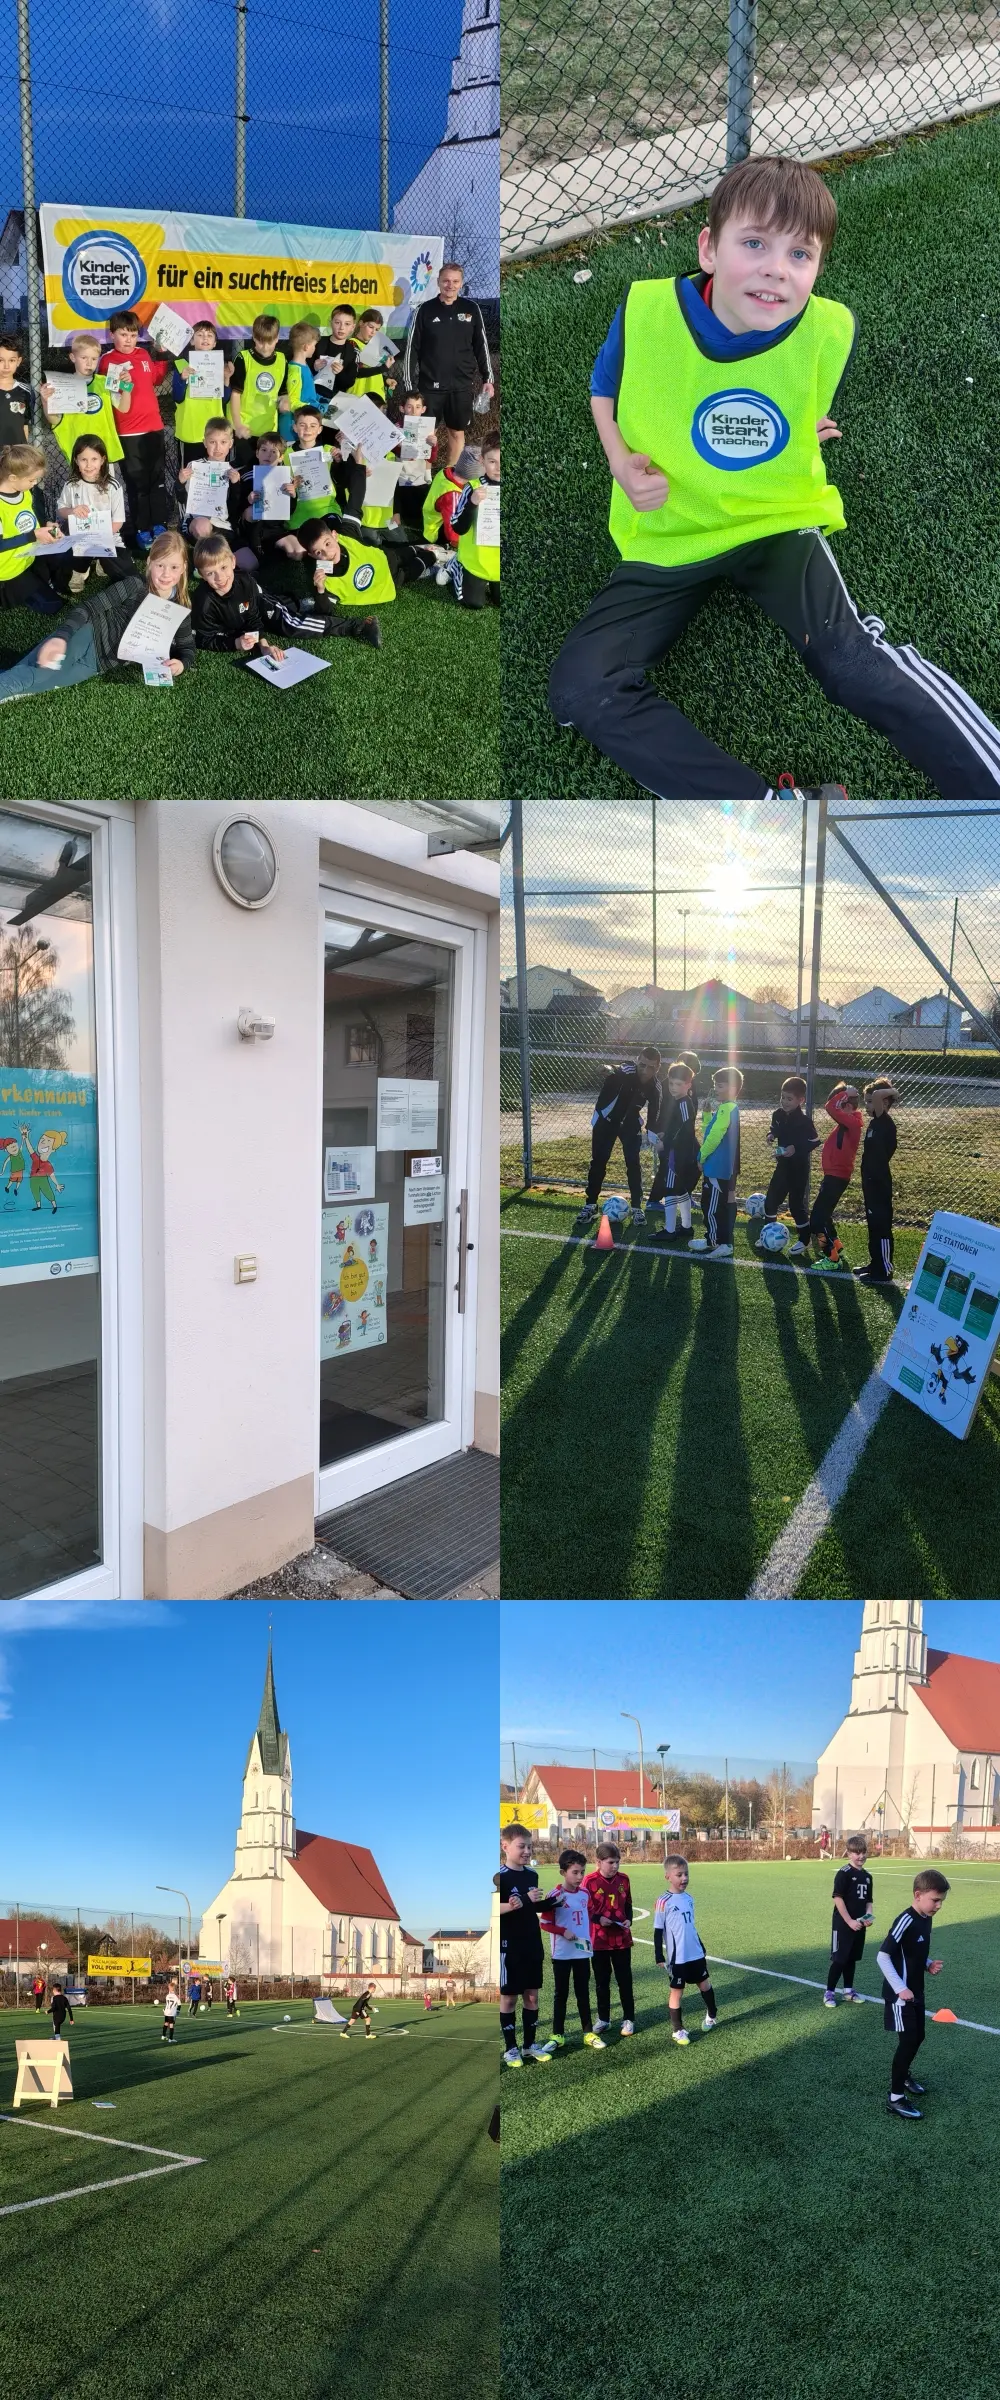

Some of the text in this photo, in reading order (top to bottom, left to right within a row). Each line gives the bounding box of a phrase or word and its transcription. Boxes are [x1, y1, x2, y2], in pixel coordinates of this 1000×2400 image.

[80, 260, 130, 273] Kinder
[80, 273, 130, 286] stark
[157, 264, 378, 294] für ein suchtfreies Leben
[80, 286, 130, 296] machen
[712, 414, 769, 425] Kinder
[712, 425, 768, 437] stark
[712, 437, 768, 447] machen
[2, 1084, 86, 1107] rkennung
[933, 1232, 943, 1242] DIE
[944, 1236, 979, 1256] STATIONEN
[857, 1884, 868, 1899] T
[608, 1894, 615, 1906] 7
[572, 1910, 584, 1926] T
[682, 1911, 692, 1924] 17
[166, 2000, 174, 2009] 17
